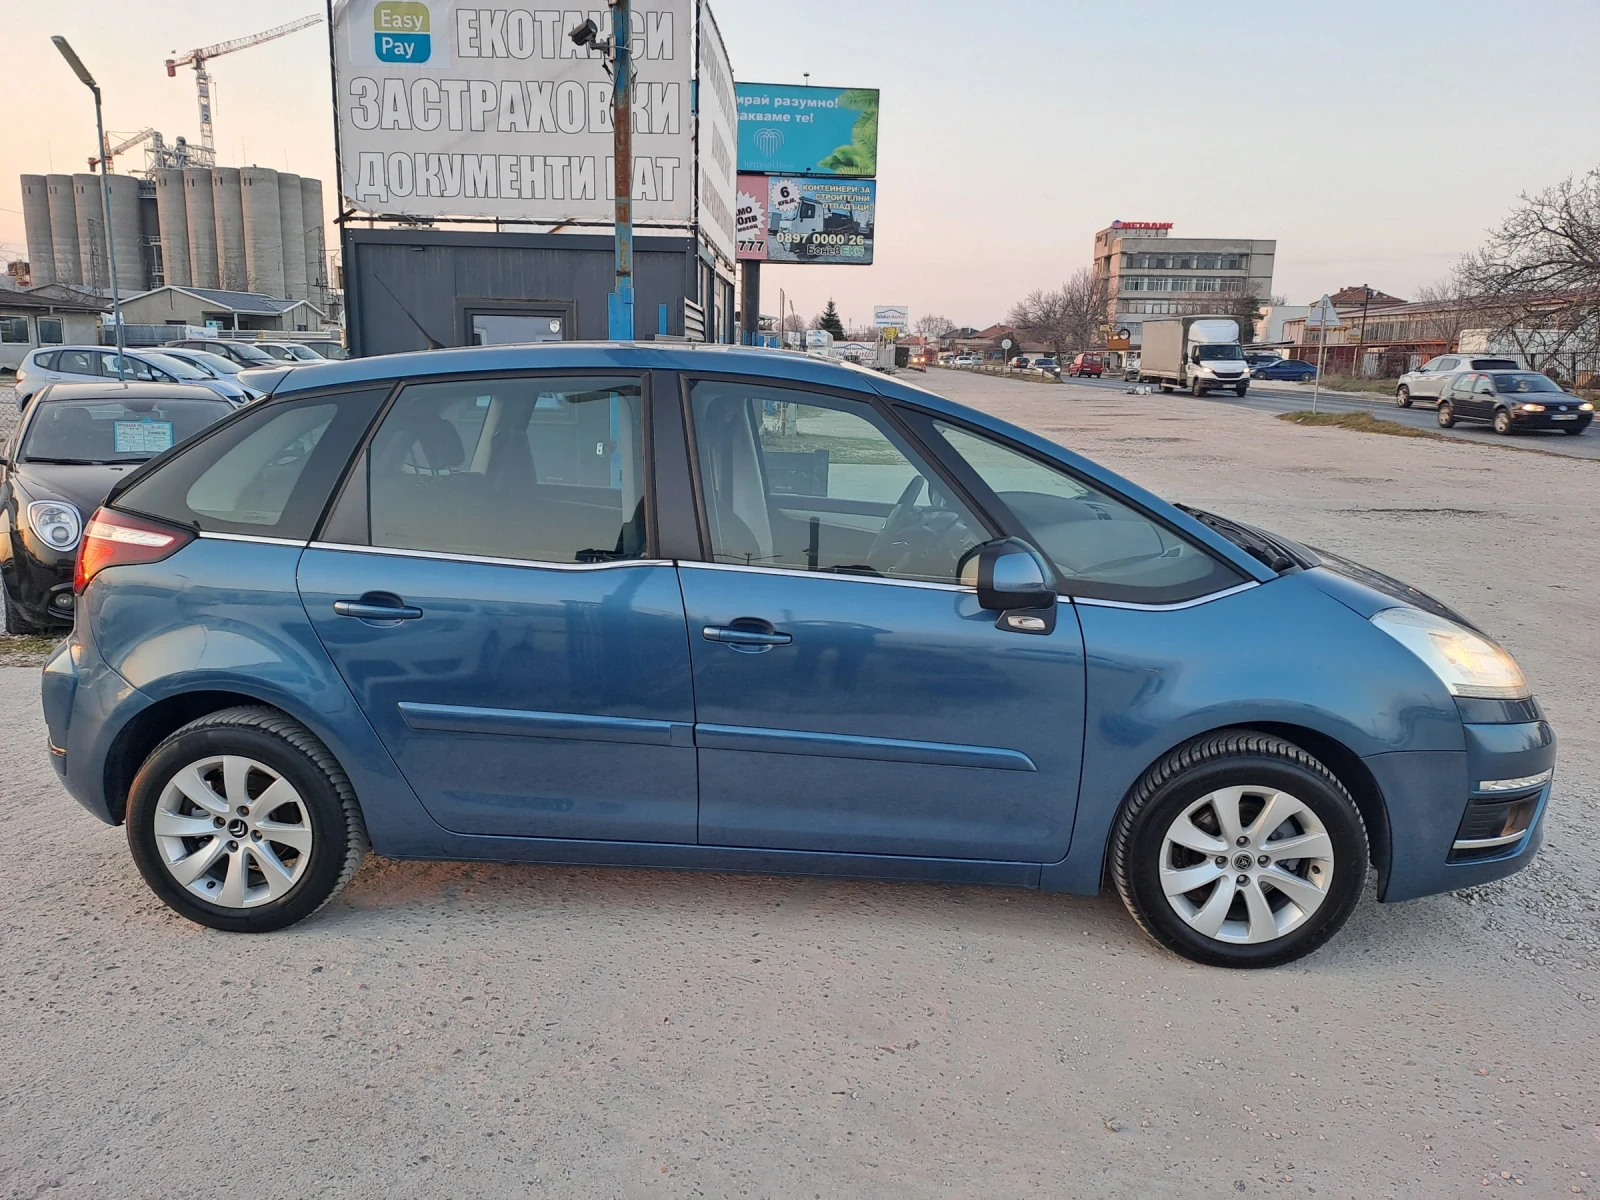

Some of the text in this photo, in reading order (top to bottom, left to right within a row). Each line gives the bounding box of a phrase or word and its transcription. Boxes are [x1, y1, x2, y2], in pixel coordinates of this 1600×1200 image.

[380, 9, 424, 31] Easy
[381, 36, 415, 59] Pay
[349, 77, 681, 134] ЗАСТРАХОВКИ
[774, 97, 839, 109] разумно!
[737, 112, 814, 123] акваме те!
[355, 151, 596, 203] ДОКУМЕНТИ
[780, 186, 790, 198] 6
[802, 184, 858, 193] КОНТЕЙНЕРИ
[815, 194, 870, 202] СТРОИТЕЛНИ
[736, 206, 753, 217] МО
[822, 203, 870, 211] ОТПАДЪЦИ
[1121, 221, 1174, 229] МЕТАЛИК
[776, 232, 865, 245] 0897 0000 26
